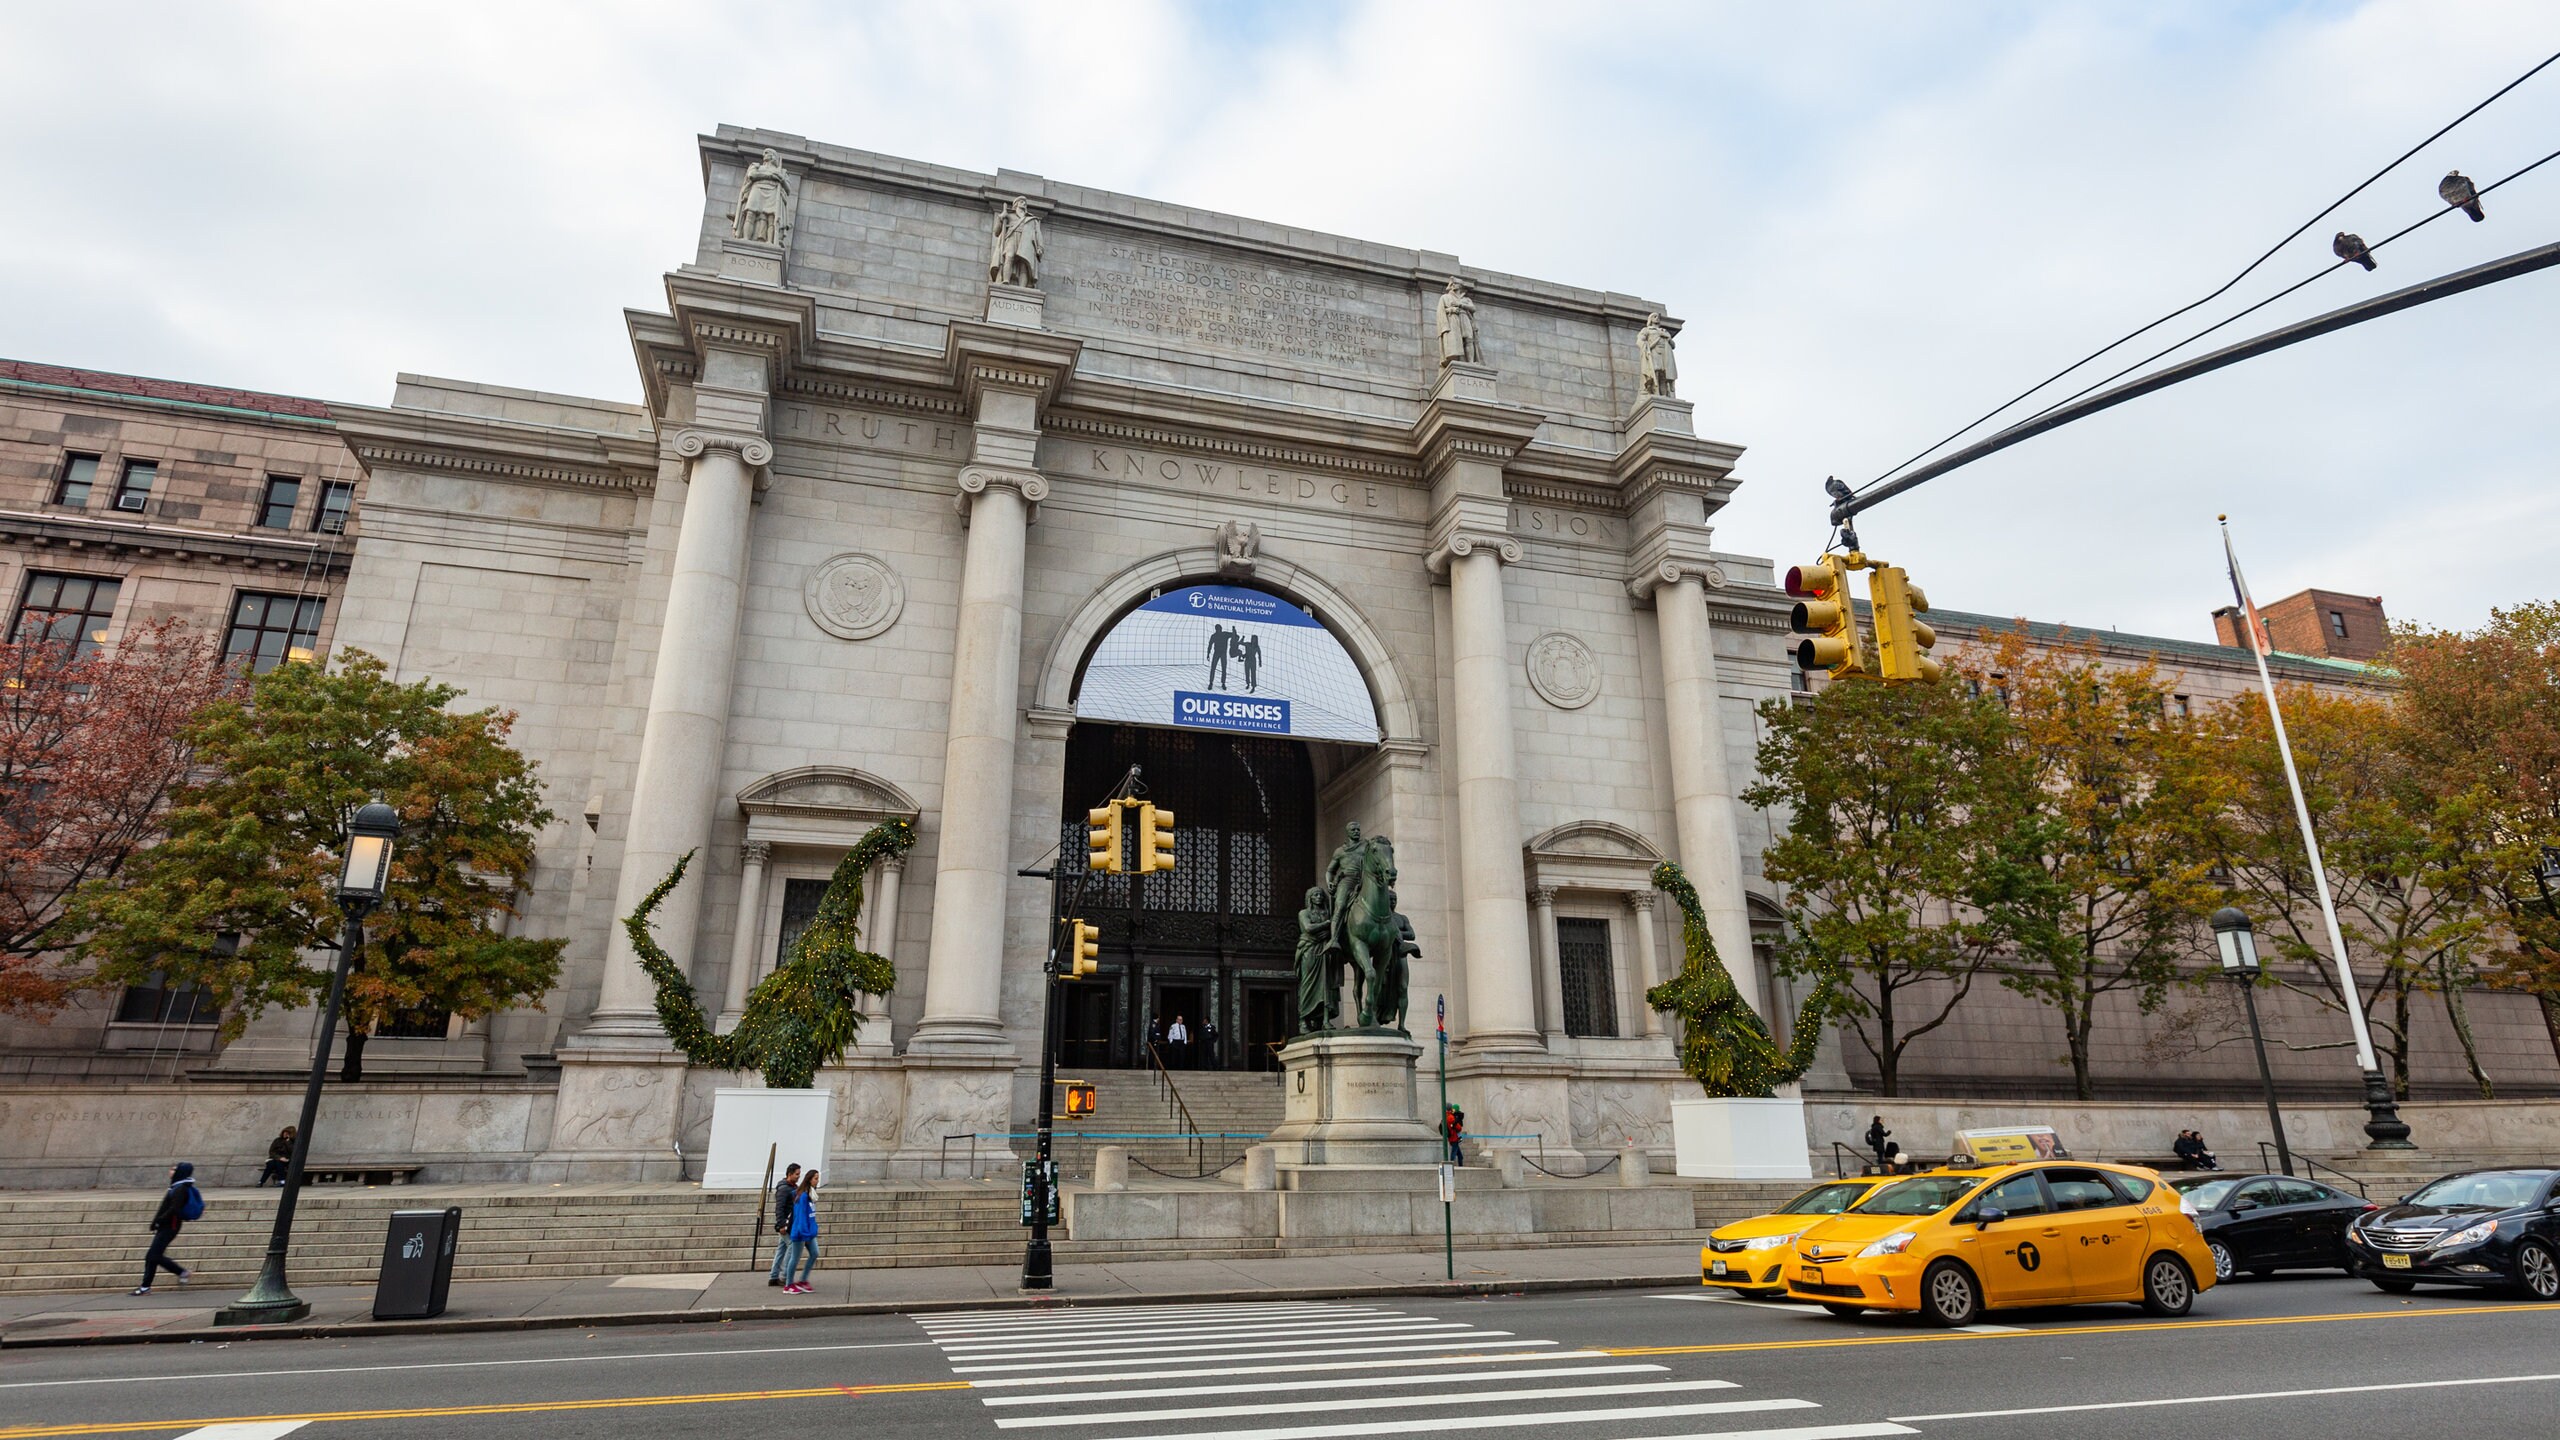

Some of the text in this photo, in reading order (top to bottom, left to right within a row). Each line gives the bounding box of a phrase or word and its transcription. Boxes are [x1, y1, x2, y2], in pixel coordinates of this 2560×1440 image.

[1111, 248, 1357, 299] STATE OF NEW YORK MEMORIAL TO
[1142, 265, 1329, 307] THEODORE ROOSEVELT
[1063, 275, 1400, 341] IN ENERGY AND FORTITUDE IN THE FAITH OF OUR FATHERS
[1092, 270, 1373, 327] A GREAT LEADER OF THE YOUTH OF AMERICA
[1089, 302, 1376, 358] IN THE LOVE AND CONSERVATION OF NATURE
[1101, 293, 1366, 346] IN DEFENSE OF THE RIGHTS OF THE PEOPLE
[1112, 317, 1355, 364] AND OF THE BEST IN LIFE AND IN MAN
[787, 406, 957, 450] TRUTH
[1091, 448, 1379, 509] KNOWLEDGE
[1514, 508, 1616, 540] ISION
[1208, 594, 1276, 608] AMERICAN MUSEUM
[1214, 603, 1244, 613] NATURAL
[1245, 606, 1273, 616] HISTORY
[1182, 698, 1283, 721] OUR SENSES
[1196, 716, 1236, 726] IMMERSIVE
[1239, 720, 1281, 730] EXPERIENCE
[31, 1111, 198, 1122] CONSERVATIONIST
[319, 1110, 413, 1120] ATURALIST
[1086, 1091, 1094, 1110] 0
[1953, 1155, 1967, 1164] 4G48
[2021, 1247, 2034, 1268] T
